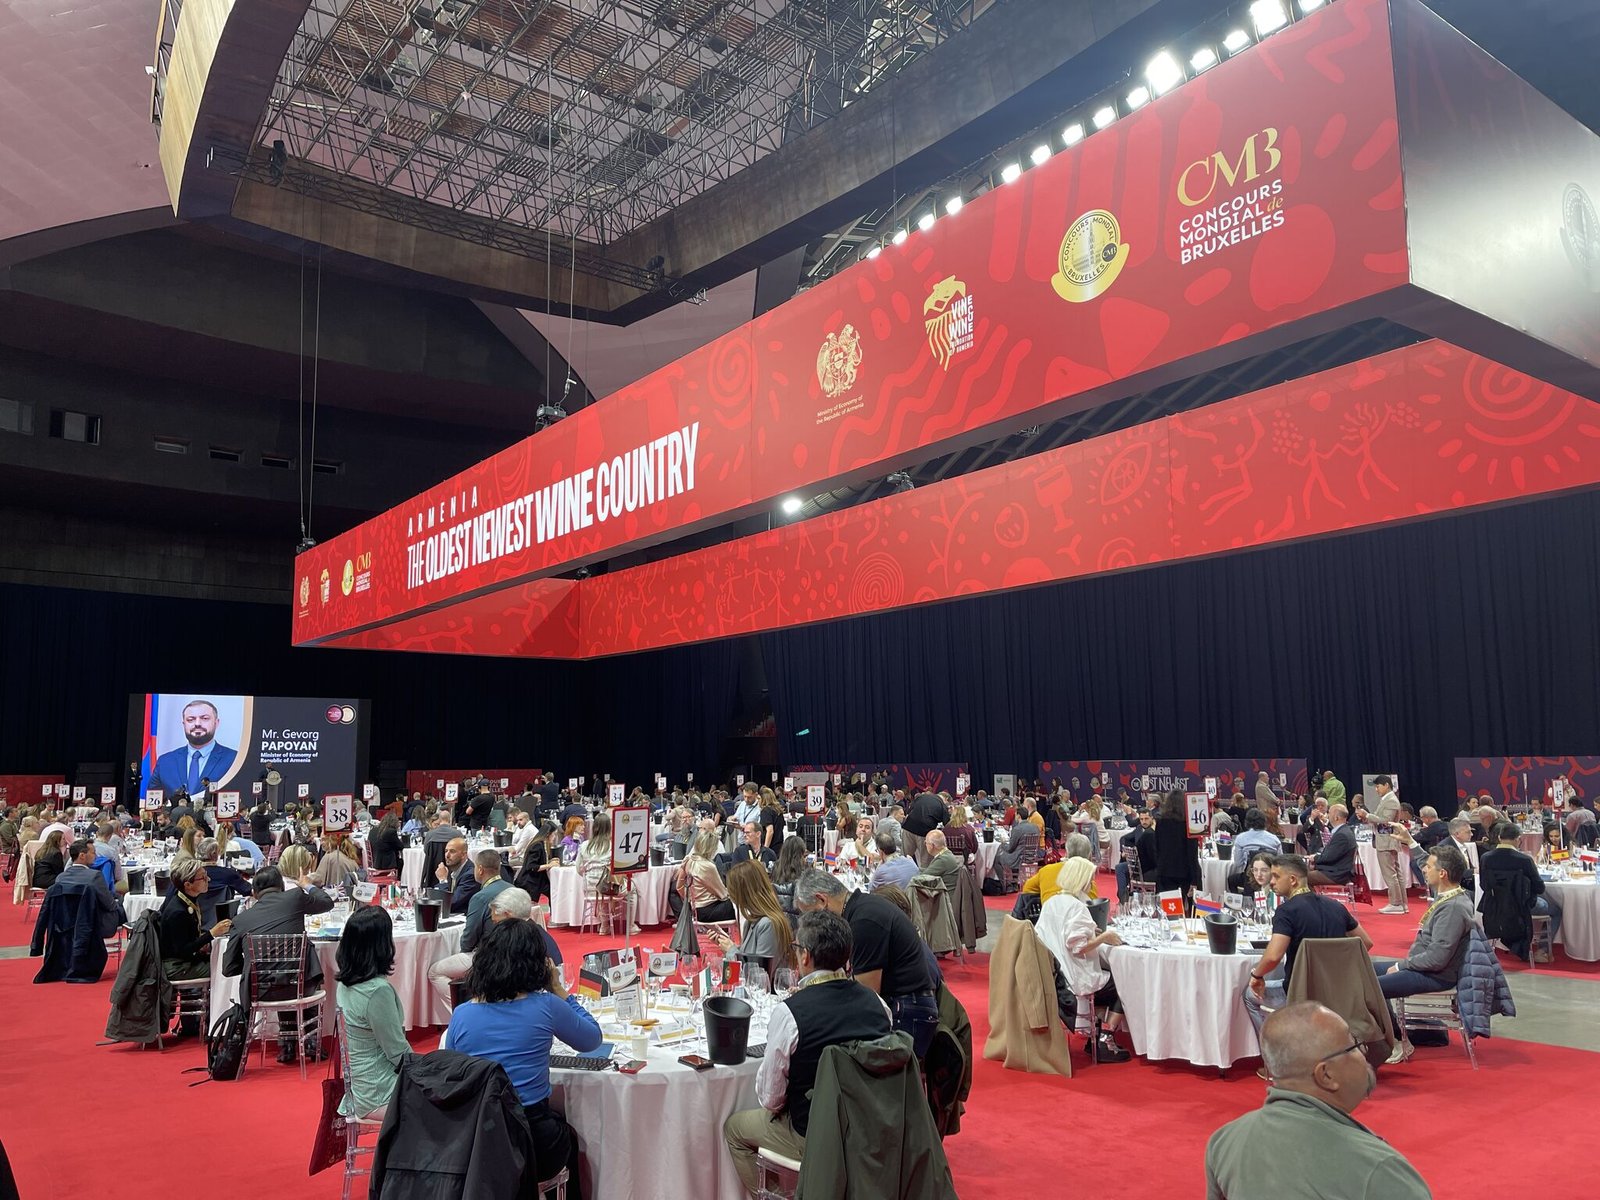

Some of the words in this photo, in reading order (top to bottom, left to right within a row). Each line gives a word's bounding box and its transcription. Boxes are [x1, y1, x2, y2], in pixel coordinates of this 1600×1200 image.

[1177, 127, 1281, 206] CMB
[1179, 179, 1283, 233] CONCOURS
[1180, 203, 1264, 248] MONDIAL
[1266, 197, 1284, 212] de
[1063, 219, 1089, 262] CONCOURS
[1092, 217, 1115, 241] MONDIAL
[1181, 210, 1285, 265] BRUXELLES
[1067, 263, 1105, 281] BRUXELLES
[951, 294, 973, 320] VINE
[948, 316, 974, 340] WINE
[407, 540, 425, 590] THE
[425, 519, 472, 584] OLDEST
[472, 493, 534, 567] NEWEST
[535, 467, 594, 545] WINE
[596, 421, 700, 522] COUNTRY
[407, 485, 478, 538] ARMENIA
[261, 729, 279, 739] Mr.
[282, 729, 320, 741] Gevorg
[261, 741, 317, 751] PAPOYAN
[148, 797, 160, 806] 26
[220, 801, 236, 813] 35
[612, 793, 622, 801] 34
[810, 795, 822, 807] 39
[329, 808, 348, 823] 38
[1191, 809, 1207, 825] 46
[619, 832, 643, 854] 47
